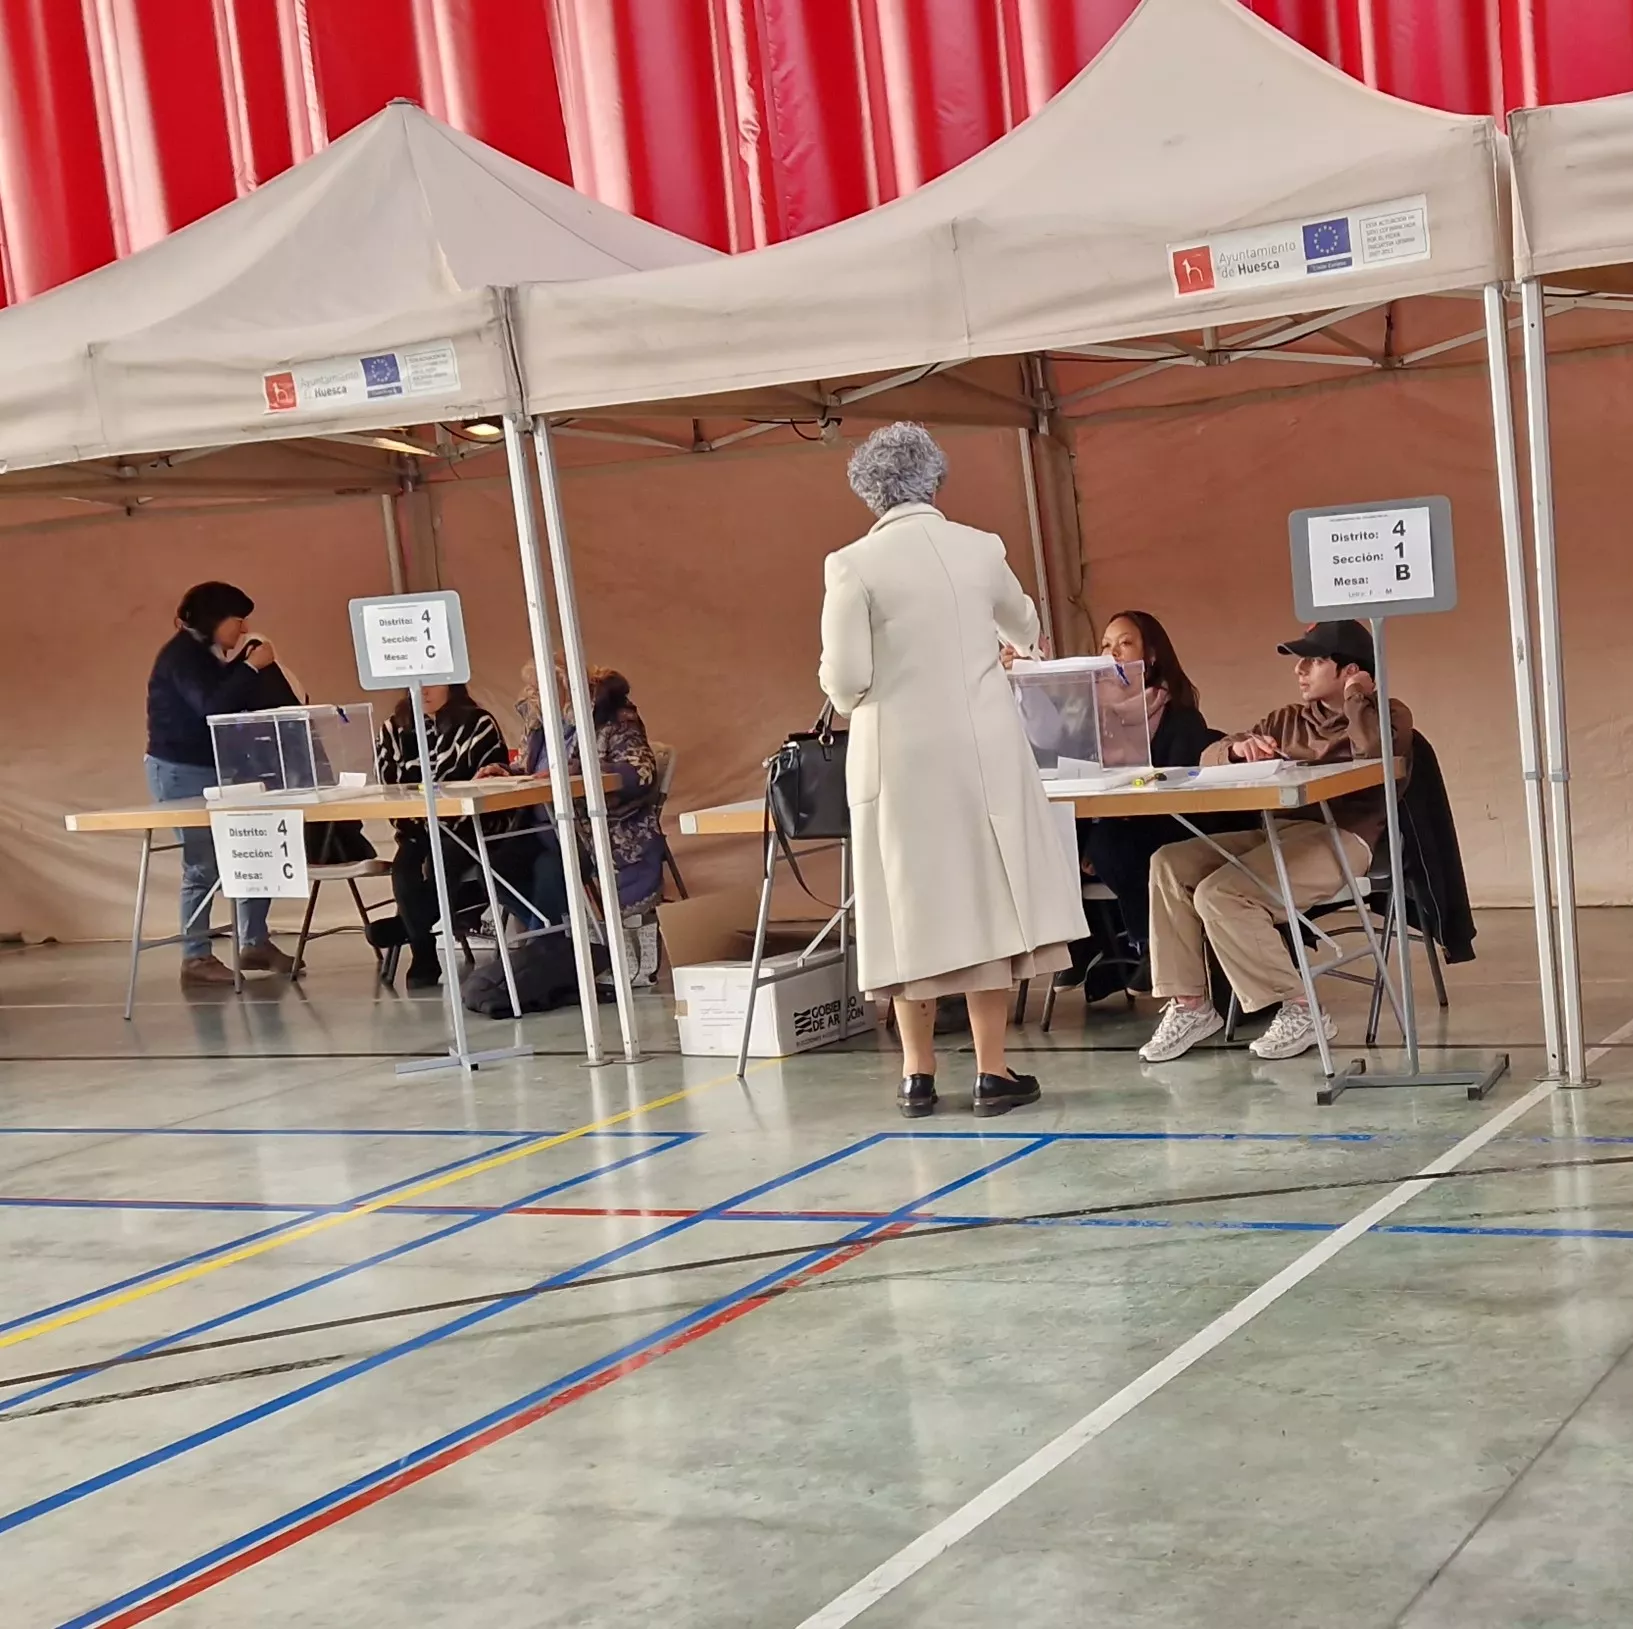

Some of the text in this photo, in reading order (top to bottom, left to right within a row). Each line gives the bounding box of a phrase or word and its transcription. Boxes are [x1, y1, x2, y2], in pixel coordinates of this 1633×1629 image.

[1219, 241, 1296, 268] Ayuntamiento
[1221, 259, 1280, 279] de Huesca
[314, 385, 348, 398] Huesca
[1331, 519, 1406, 543] Distrito: 4
[1332, 541, 1404, 565] Sección: 1
[1334, 564, 1411, 587] Mesa: B
[379, 609, 431, 627] Distrito: 4
[423, 627, 431, 641] 1
[384, 645, 436, 661] Mesa: C
[229, 819, 288, 837] Distrito: 4
[232, 841, 289, 859] Sección: 1
[234, 863, 294, 880] Mesa: C
[812, 996, 857, 1018] GOBIEO
[813, 1018, 825, 1032] DE
